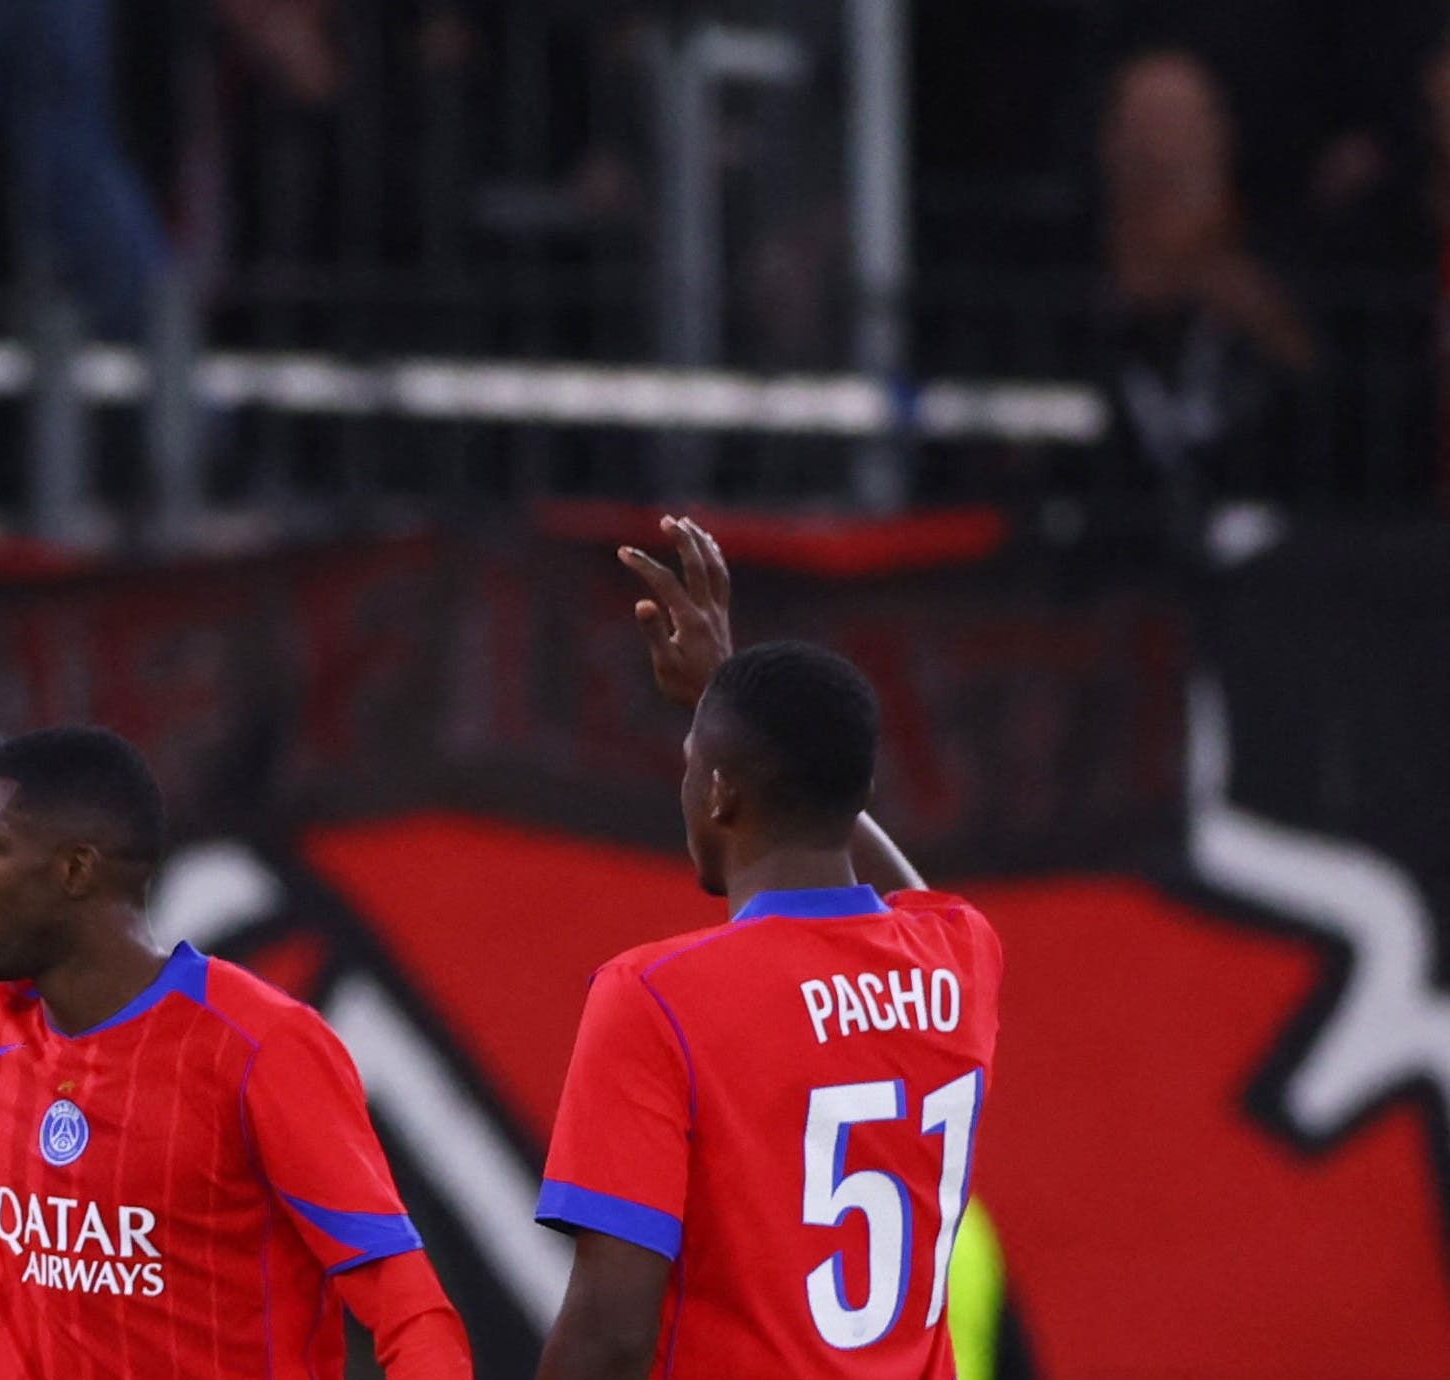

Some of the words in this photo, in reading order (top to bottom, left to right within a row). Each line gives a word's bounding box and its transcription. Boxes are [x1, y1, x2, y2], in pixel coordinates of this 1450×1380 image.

[800, 968, 961, 1043] PACHO
[801, 1067, 983, 1350] 51
[22, 1258, 165, 1297] AIRWAYS
